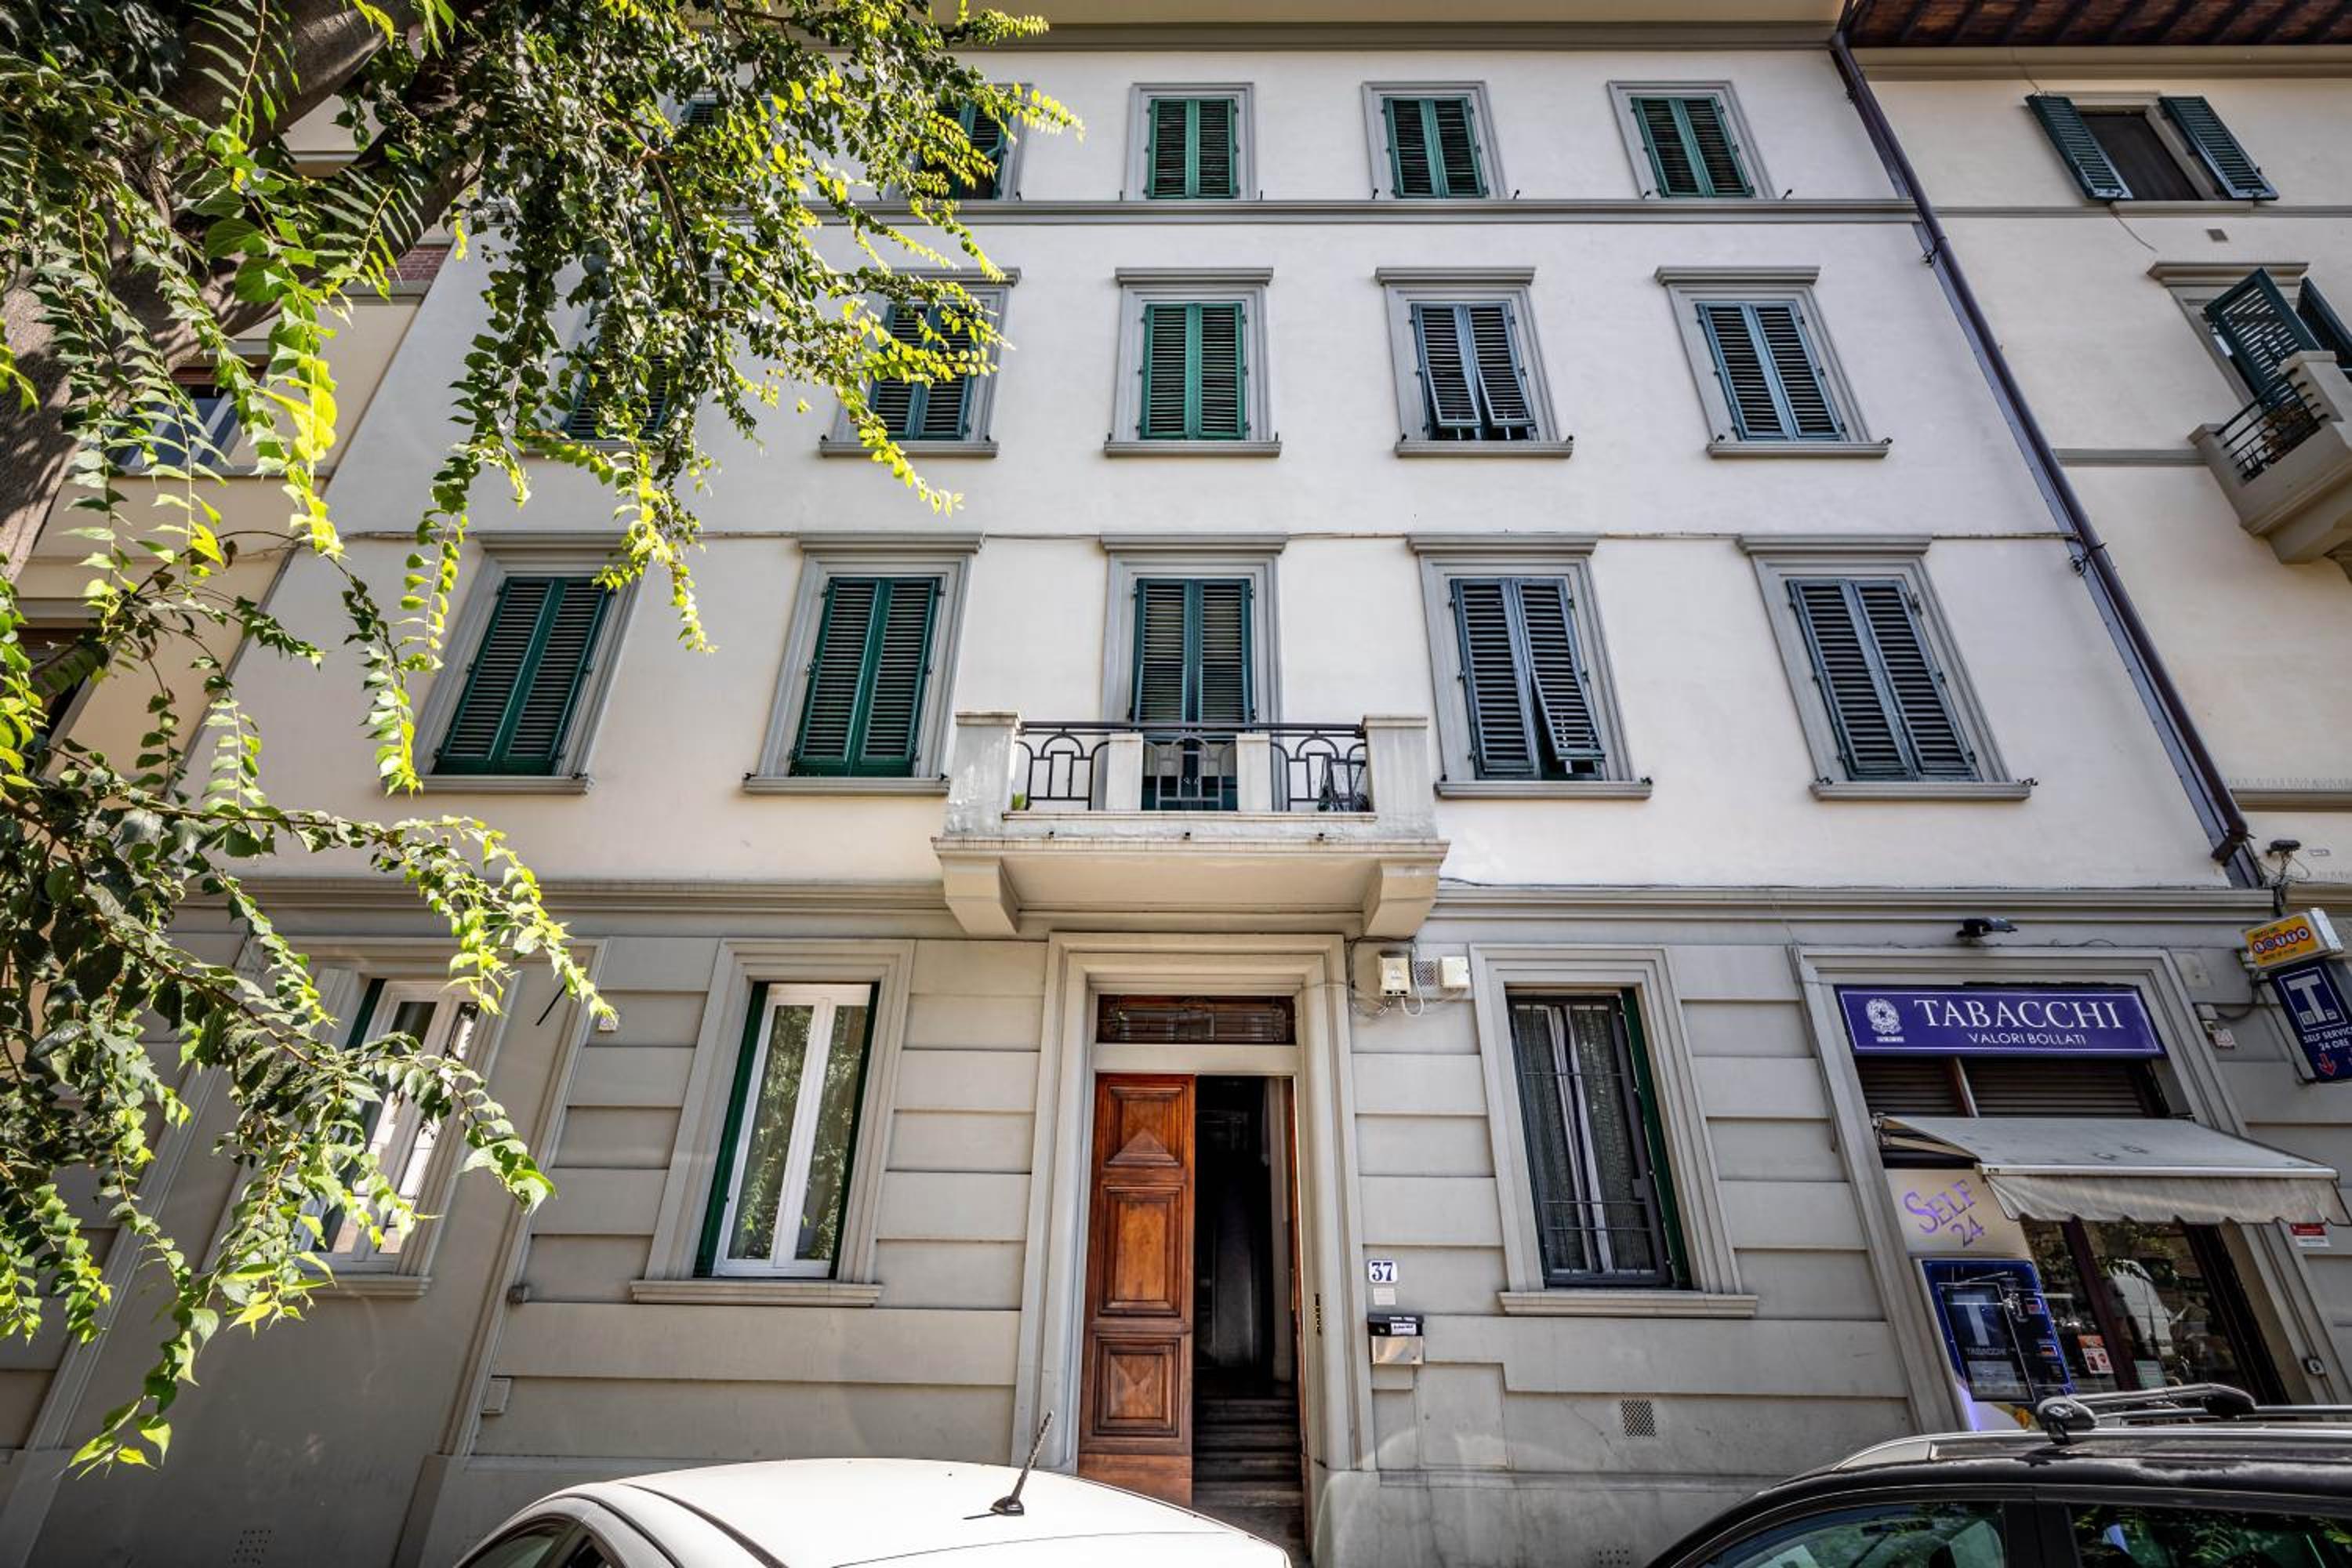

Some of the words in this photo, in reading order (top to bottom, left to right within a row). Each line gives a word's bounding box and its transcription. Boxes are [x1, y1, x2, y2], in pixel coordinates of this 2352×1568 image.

[2254, 927, 2309, 953] LOTTO
[2287, 974, 2326, 1023] T
[1914, 1000, 2124, 1029] TABACCHI
[1968, 1033, 2025, 1044] VALORI
[2027, 1033, 2086, 1045] BOLLATI
[2303, 1033, 2321, 1044] SELF
[2318, 1042, 2331, 1051] 24
[2332, 1038, 2350, 1048] ORE
[1950, 1214, 1984, 1247] 24
[1371, 1262, 1393, 1281] 37
